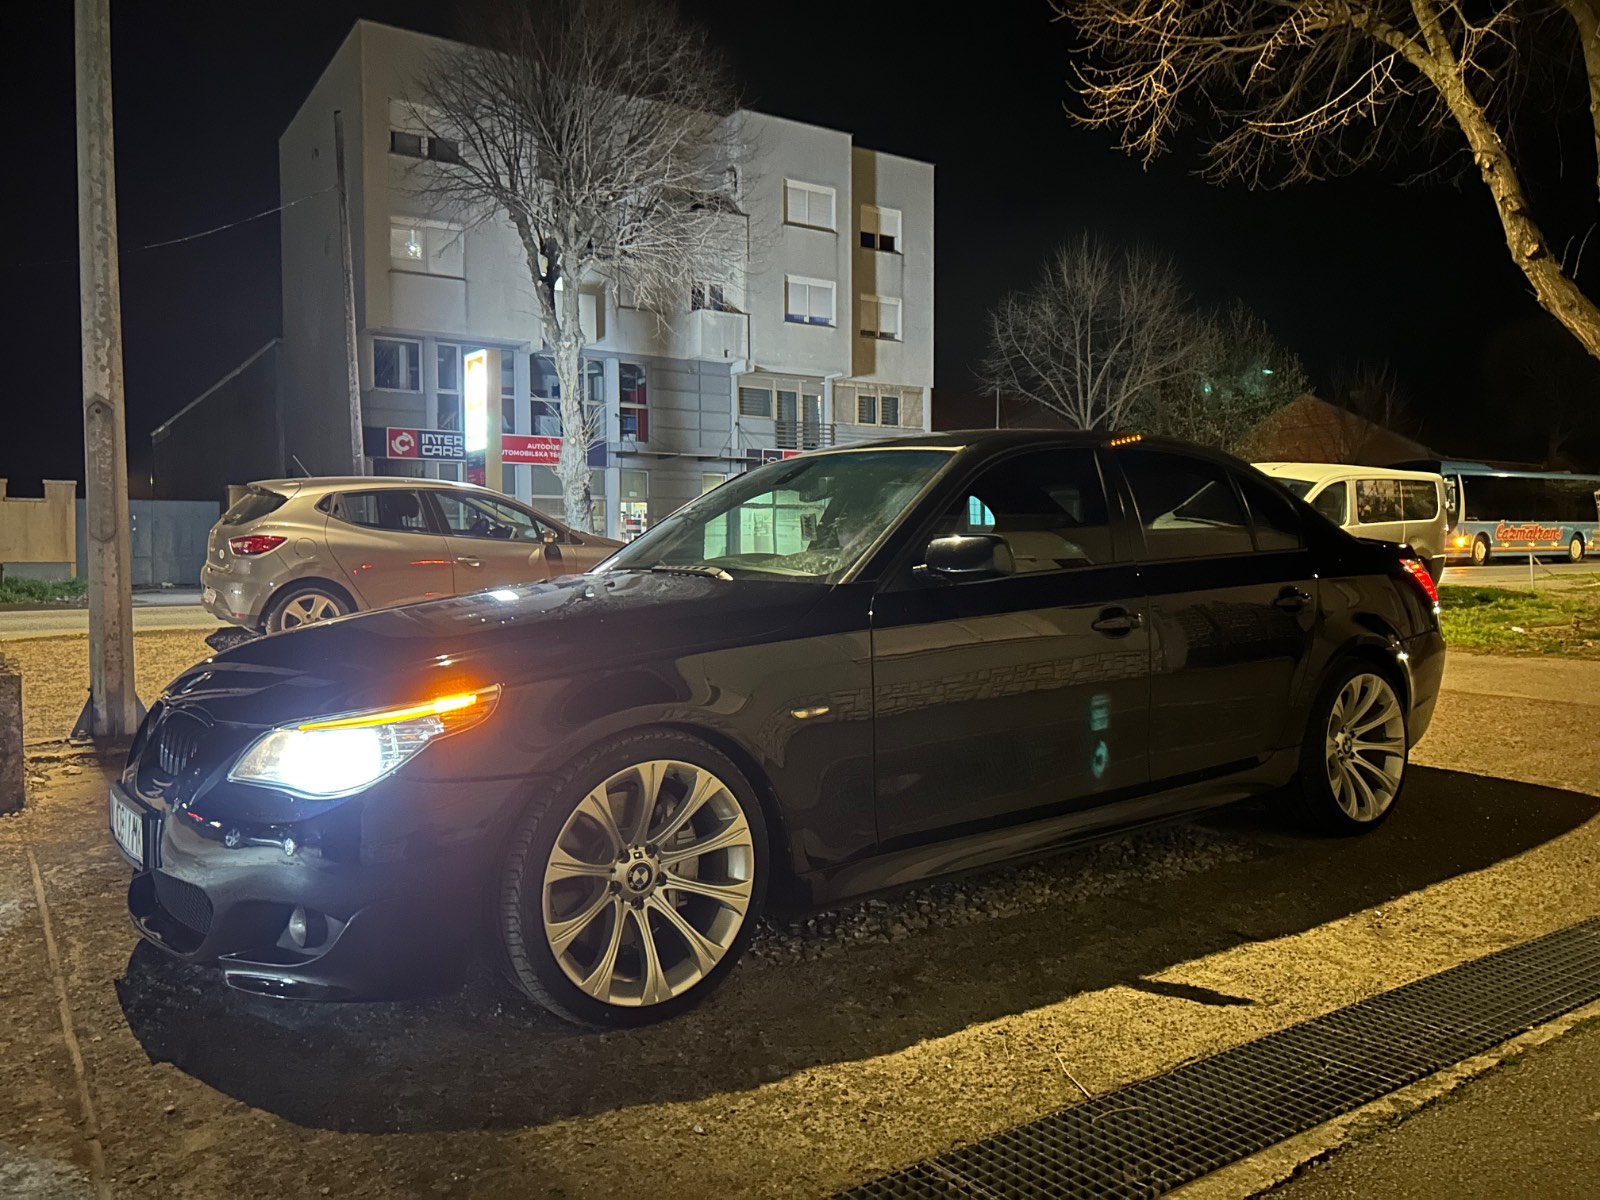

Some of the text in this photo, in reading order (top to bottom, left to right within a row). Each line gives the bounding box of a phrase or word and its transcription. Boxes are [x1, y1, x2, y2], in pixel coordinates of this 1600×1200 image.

[421, 433, 464, 446] INTER
[421, 445, 464, 457] CARS
[501, 449, 548, 458] UTOMOBILSKA
